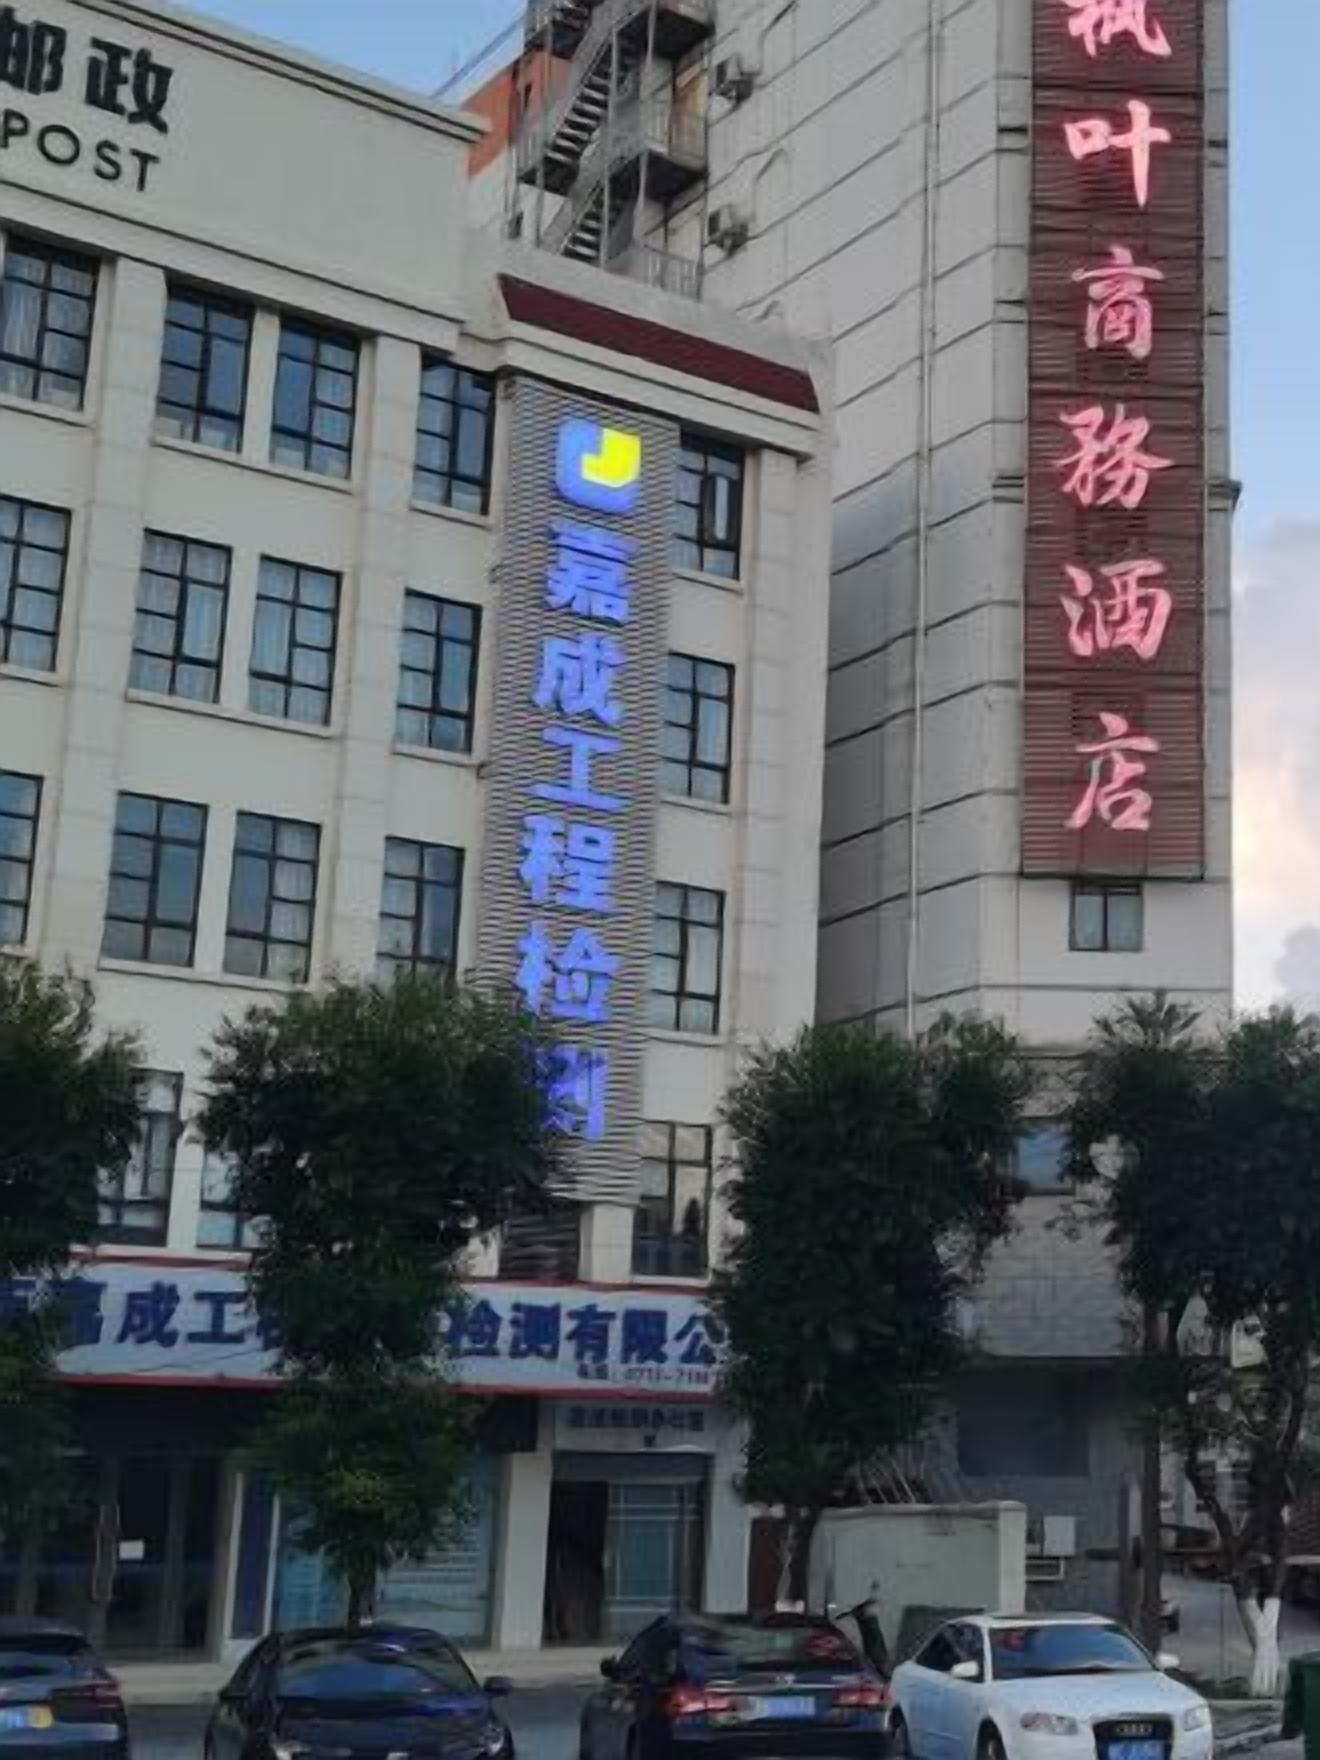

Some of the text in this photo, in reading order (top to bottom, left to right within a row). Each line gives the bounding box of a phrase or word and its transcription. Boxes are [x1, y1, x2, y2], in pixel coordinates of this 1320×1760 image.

[0, 6, 174, 134] 邮政
[0, 108, 161, 192] POST
[513, 522, 637, 1142] 嘉成工程检测
